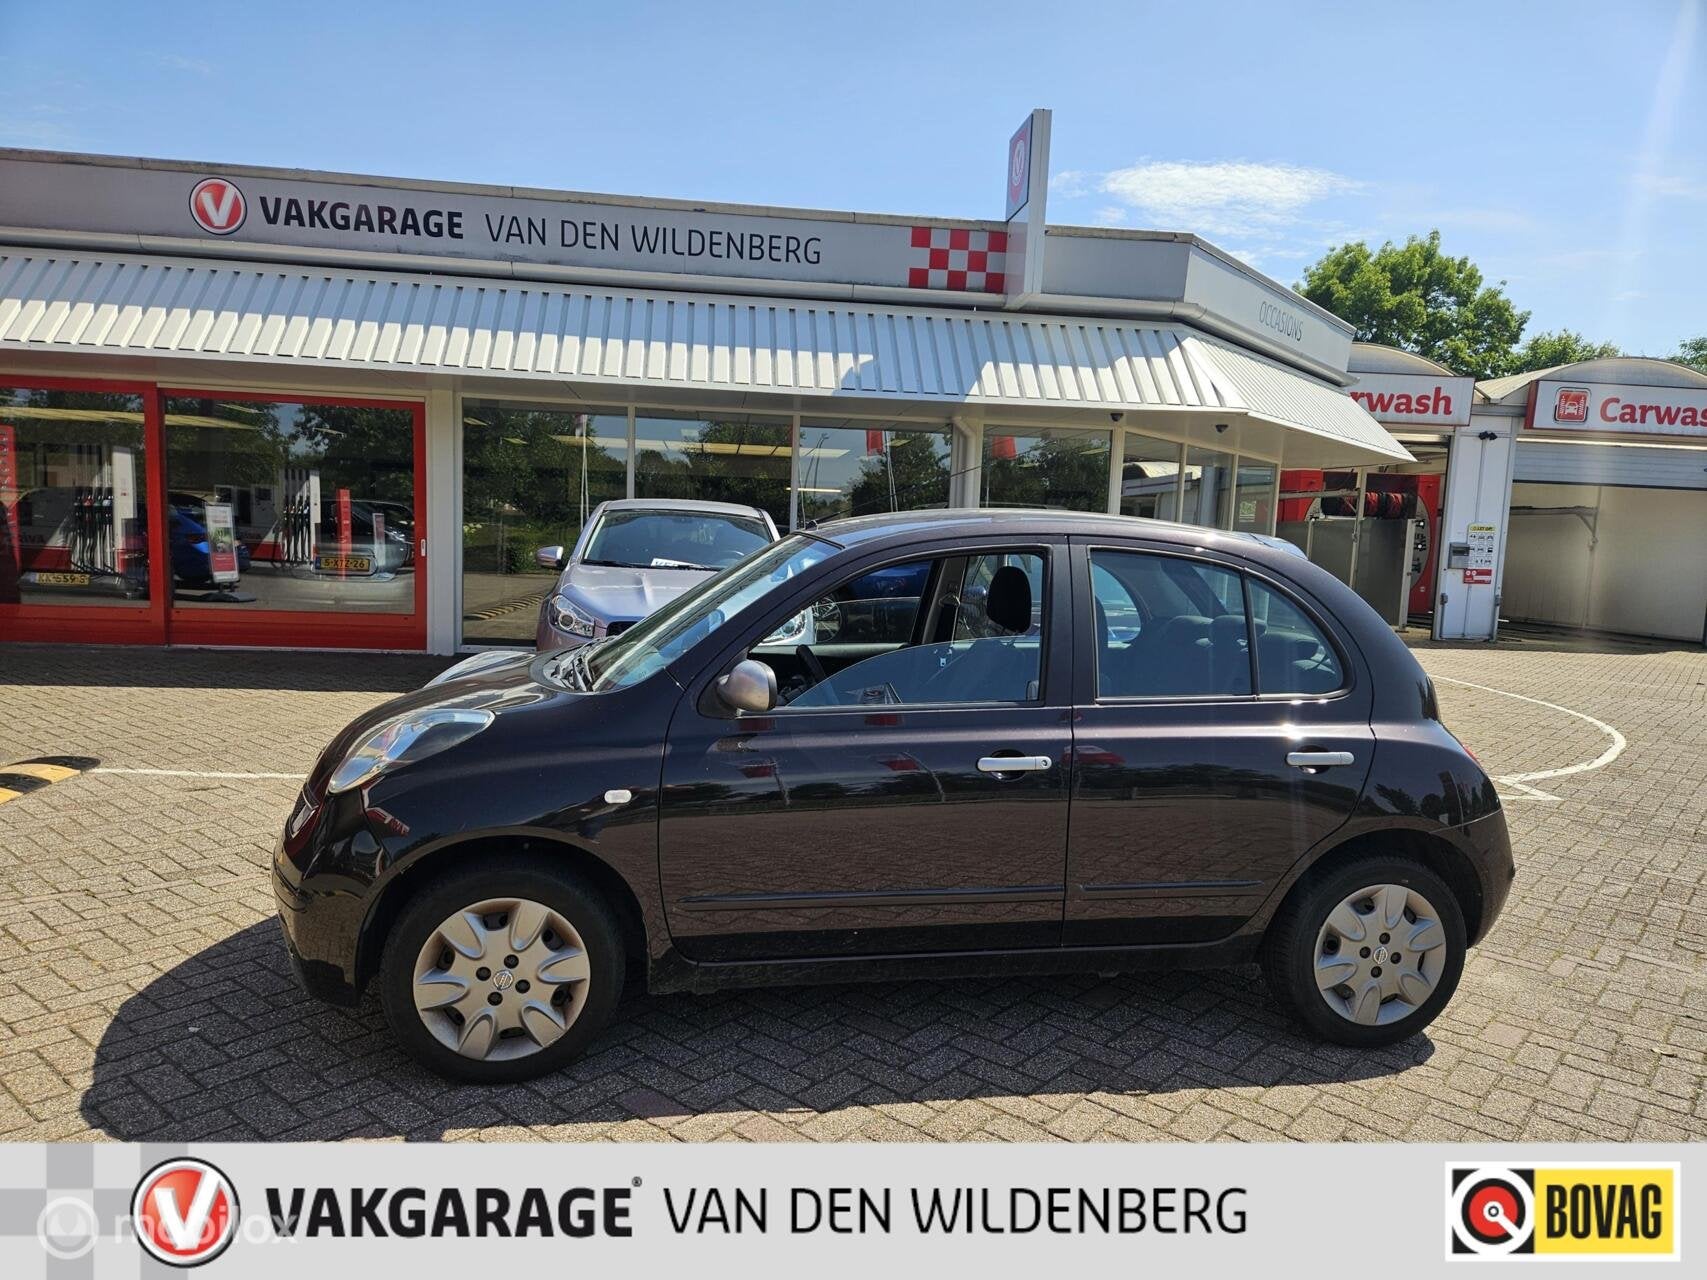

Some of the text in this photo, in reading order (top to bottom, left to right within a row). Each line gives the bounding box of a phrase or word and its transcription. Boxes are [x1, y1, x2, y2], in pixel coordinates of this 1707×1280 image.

[258, 195, 464, 240] VAKGARAGE
[485, 213, 547, 246] VAN
[560, 219, 619, 252] DEN
[631, 224, 822, 265] WILDENBERG
[1259, 300, 1304, 342] OCCASIONS
